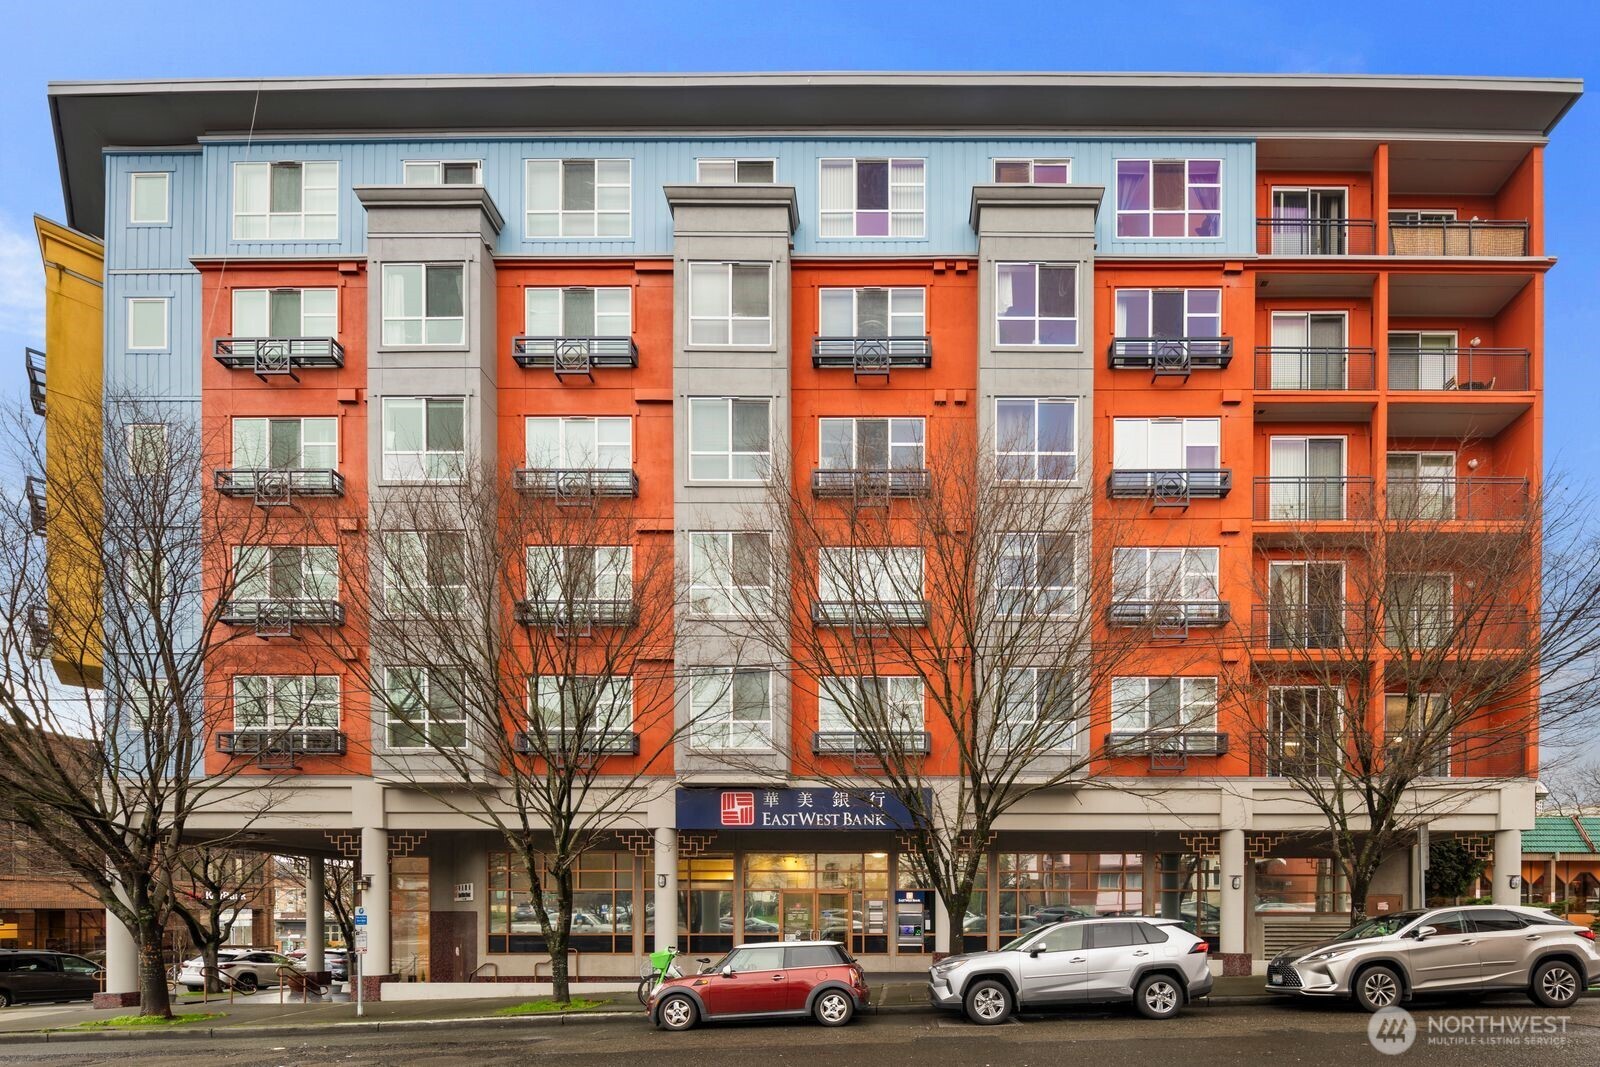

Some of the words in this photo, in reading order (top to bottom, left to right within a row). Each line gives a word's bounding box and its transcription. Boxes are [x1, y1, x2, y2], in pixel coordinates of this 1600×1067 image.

[763, 792, 886, 808] 華美銀行
[842, 812, 886, 826] BANK
